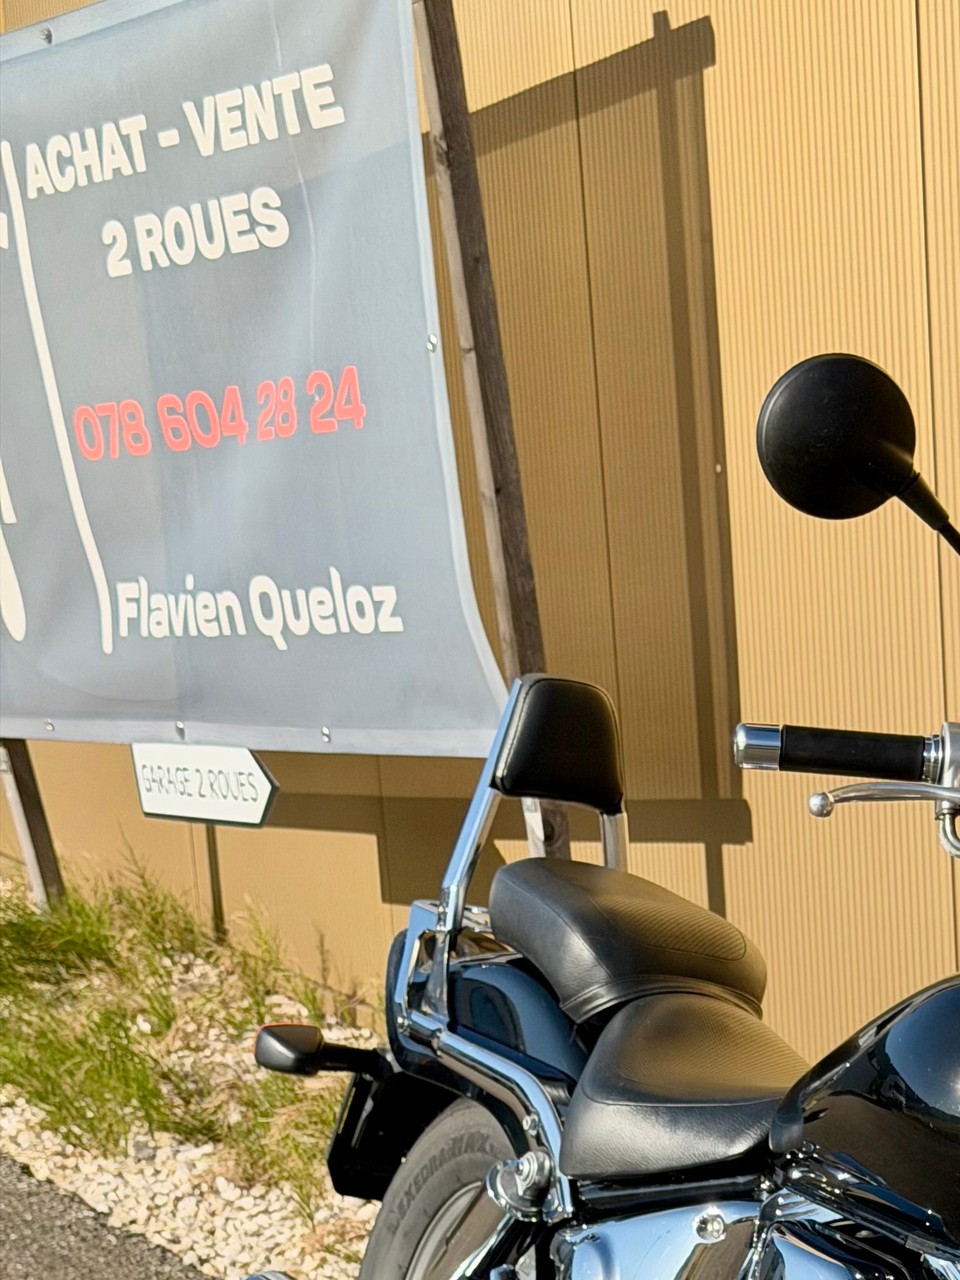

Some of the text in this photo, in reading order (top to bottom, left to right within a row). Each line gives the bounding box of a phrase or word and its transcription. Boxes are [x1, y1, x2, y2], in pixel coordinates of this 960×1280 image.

[26, 63, 346, 200] ACHAT - VENTE
[101, 186, 290, 278] 2 ROUES
[73, 365, 367, 461] 078 604 28 24
[116, 565, 405, 651] Flavien Queloz
[142, 764, 259, 803] GARAGE 2 ROUES
